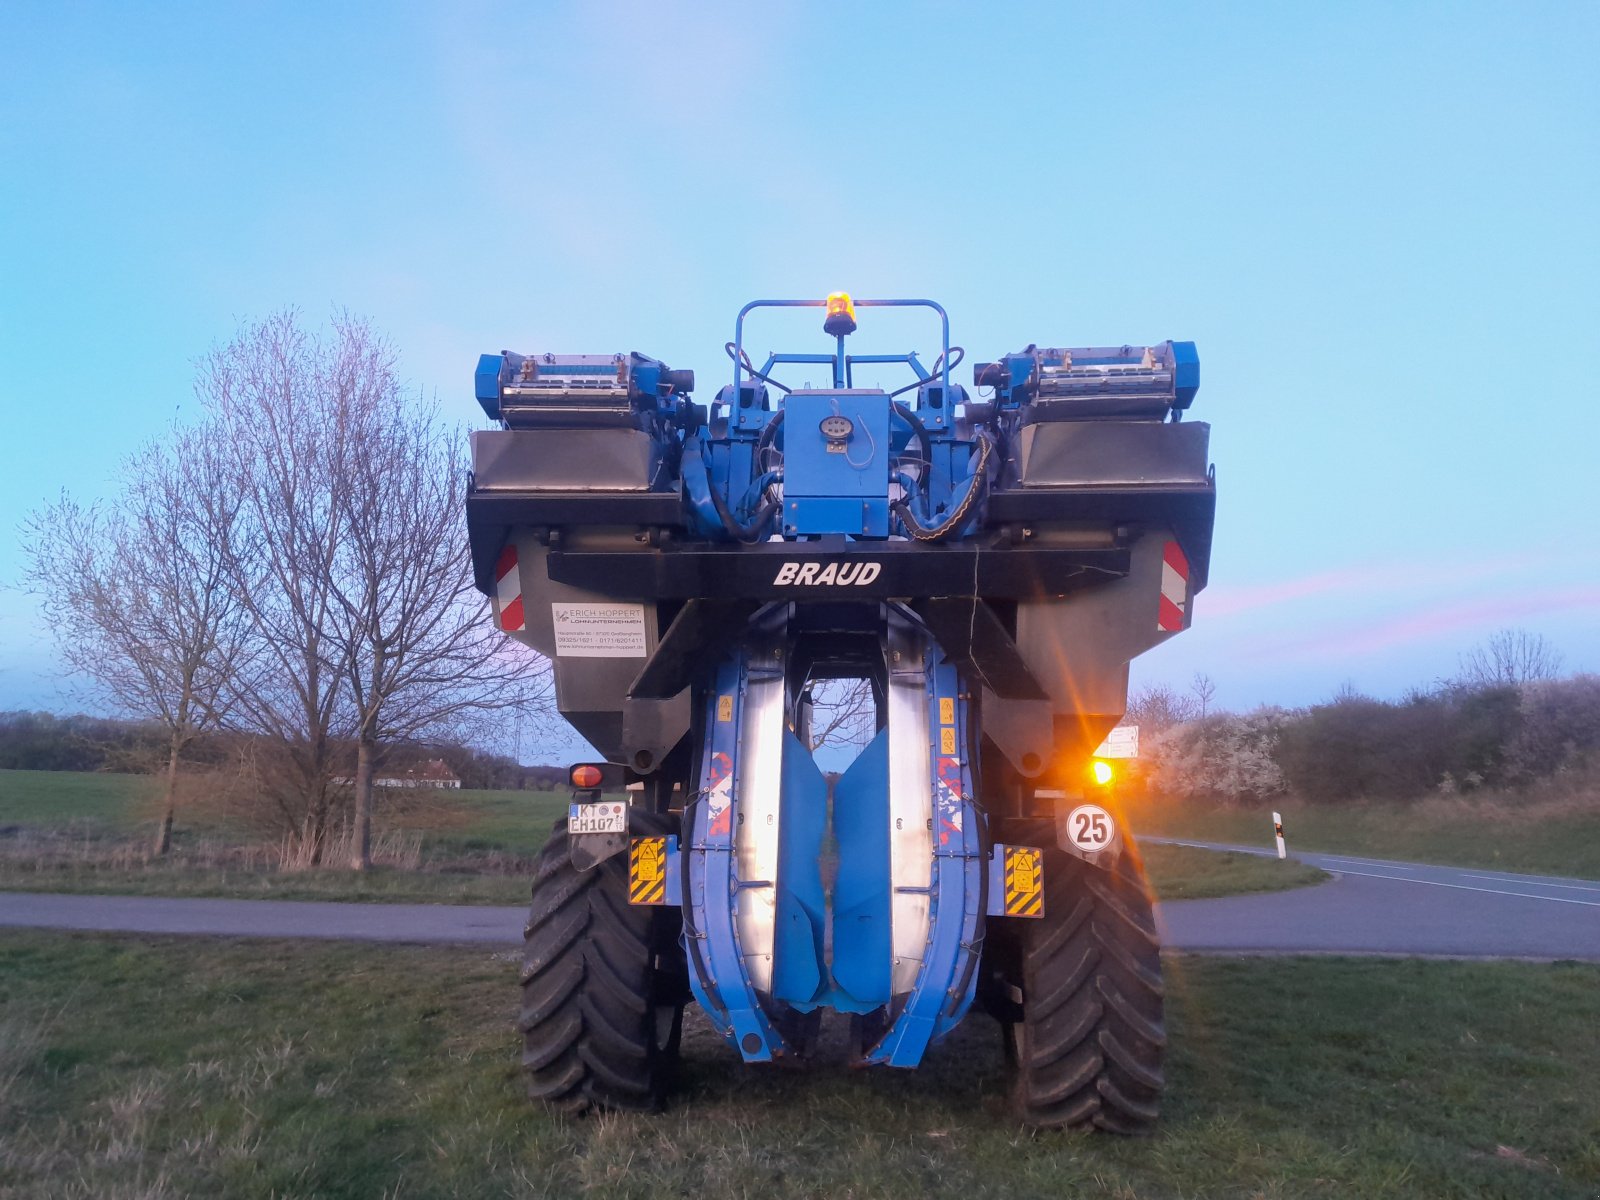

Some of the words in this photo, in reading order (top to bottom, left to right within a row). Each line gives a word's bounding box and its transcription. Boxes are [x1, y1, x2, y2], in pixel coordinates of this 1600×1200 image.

[773, 562, 882, 586] BRAUD
[570, 609, 596, 617] ERICH
[600, 609, 641, 617] HOPPERT
[580, 804, 598, 817] KT
[571, 818, 614, 831] EH107
[1075, 813, 1108, 843] 25
